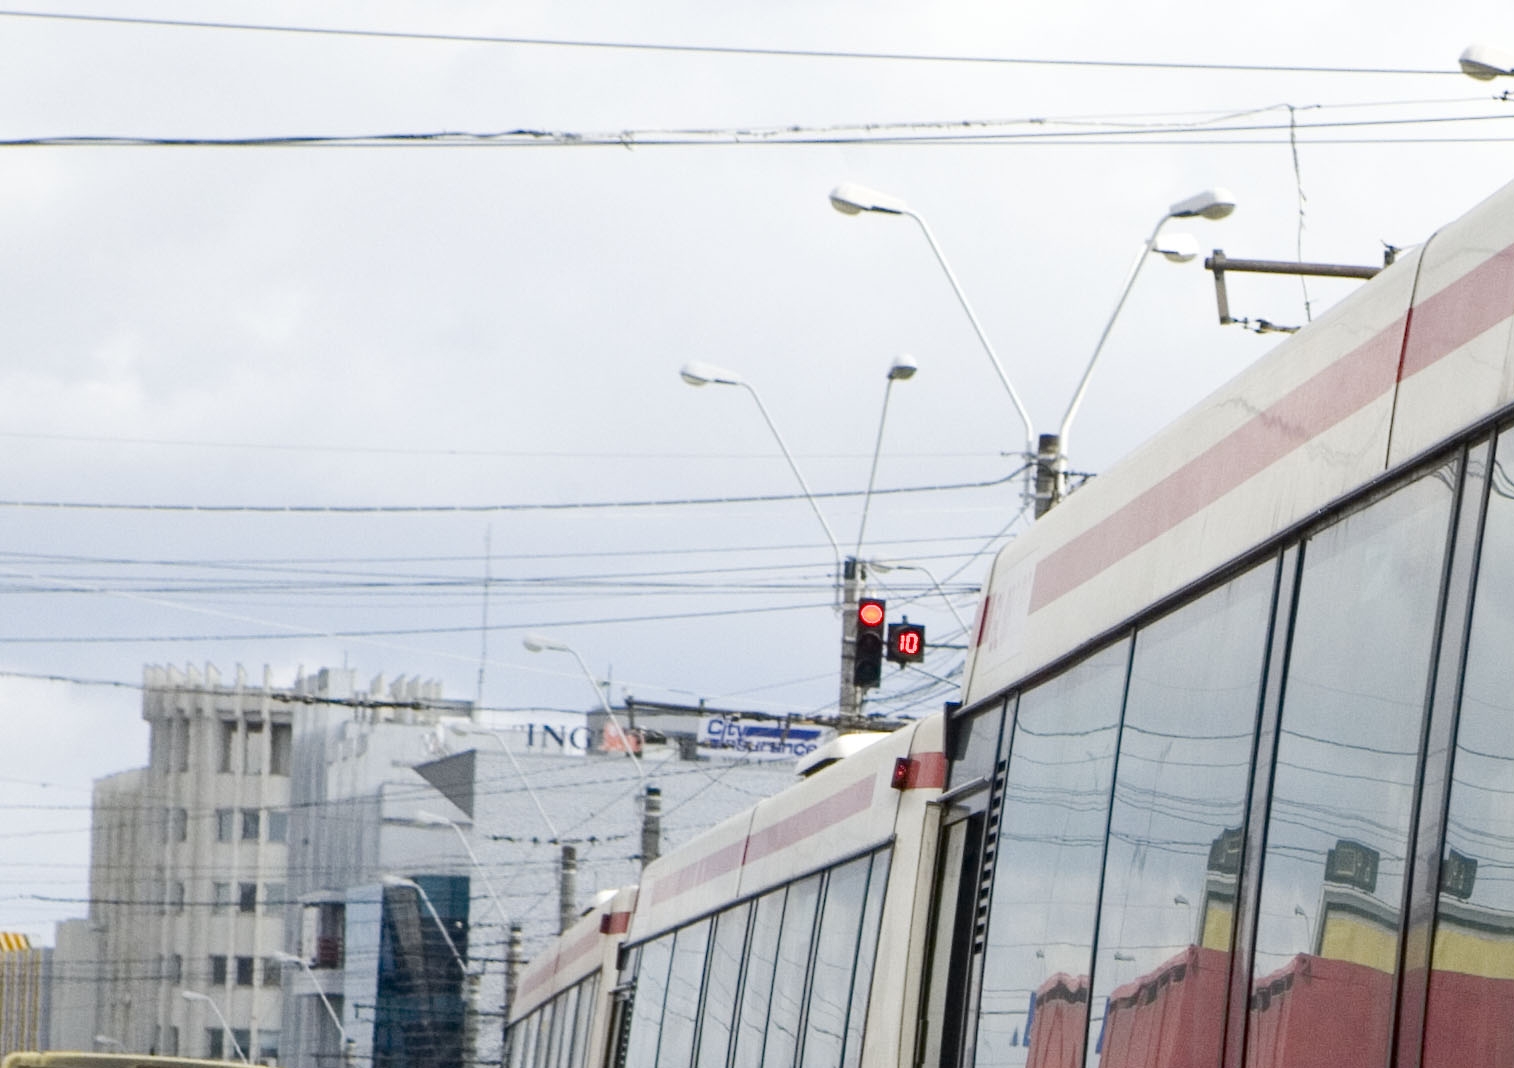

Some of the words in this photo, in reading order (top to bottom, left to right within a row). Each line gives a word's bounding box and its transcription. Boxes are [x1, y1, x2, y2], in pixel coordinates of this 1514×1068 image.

[899, 632, 919, 654] 10
[526, 722, 592, 750] ING
[707, 718, 743, 743] City
